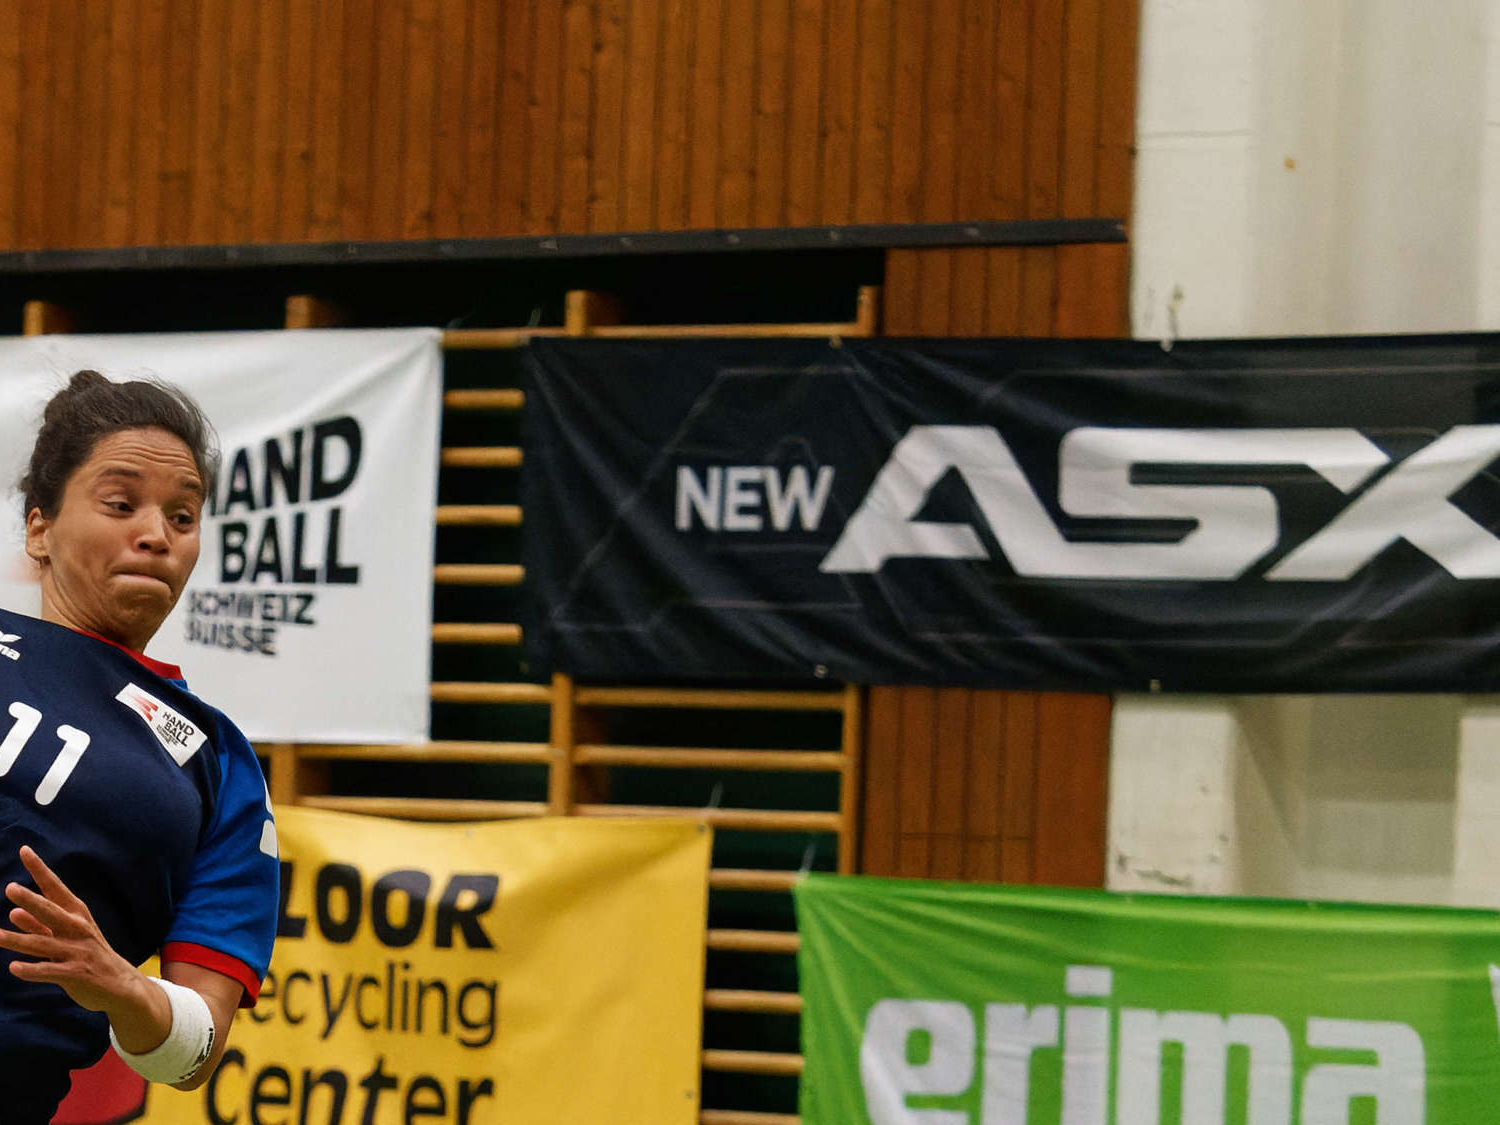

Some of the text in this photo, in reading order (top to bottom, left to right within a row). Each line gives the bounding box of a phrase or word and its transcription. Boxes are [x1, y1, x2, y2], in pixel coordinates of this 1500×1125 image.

[674, 423, 1500, 581] NEW ASX
[220, 507, 360, 584] BALL
[188, 590, 315, 625] SCHWEIZ
[162, 711, 195, 736] HAND
[164, 722, 189, 747] BALL
[276, 861, 500, 949] LOOR
[236, 961, 498, 1048] ecycling
